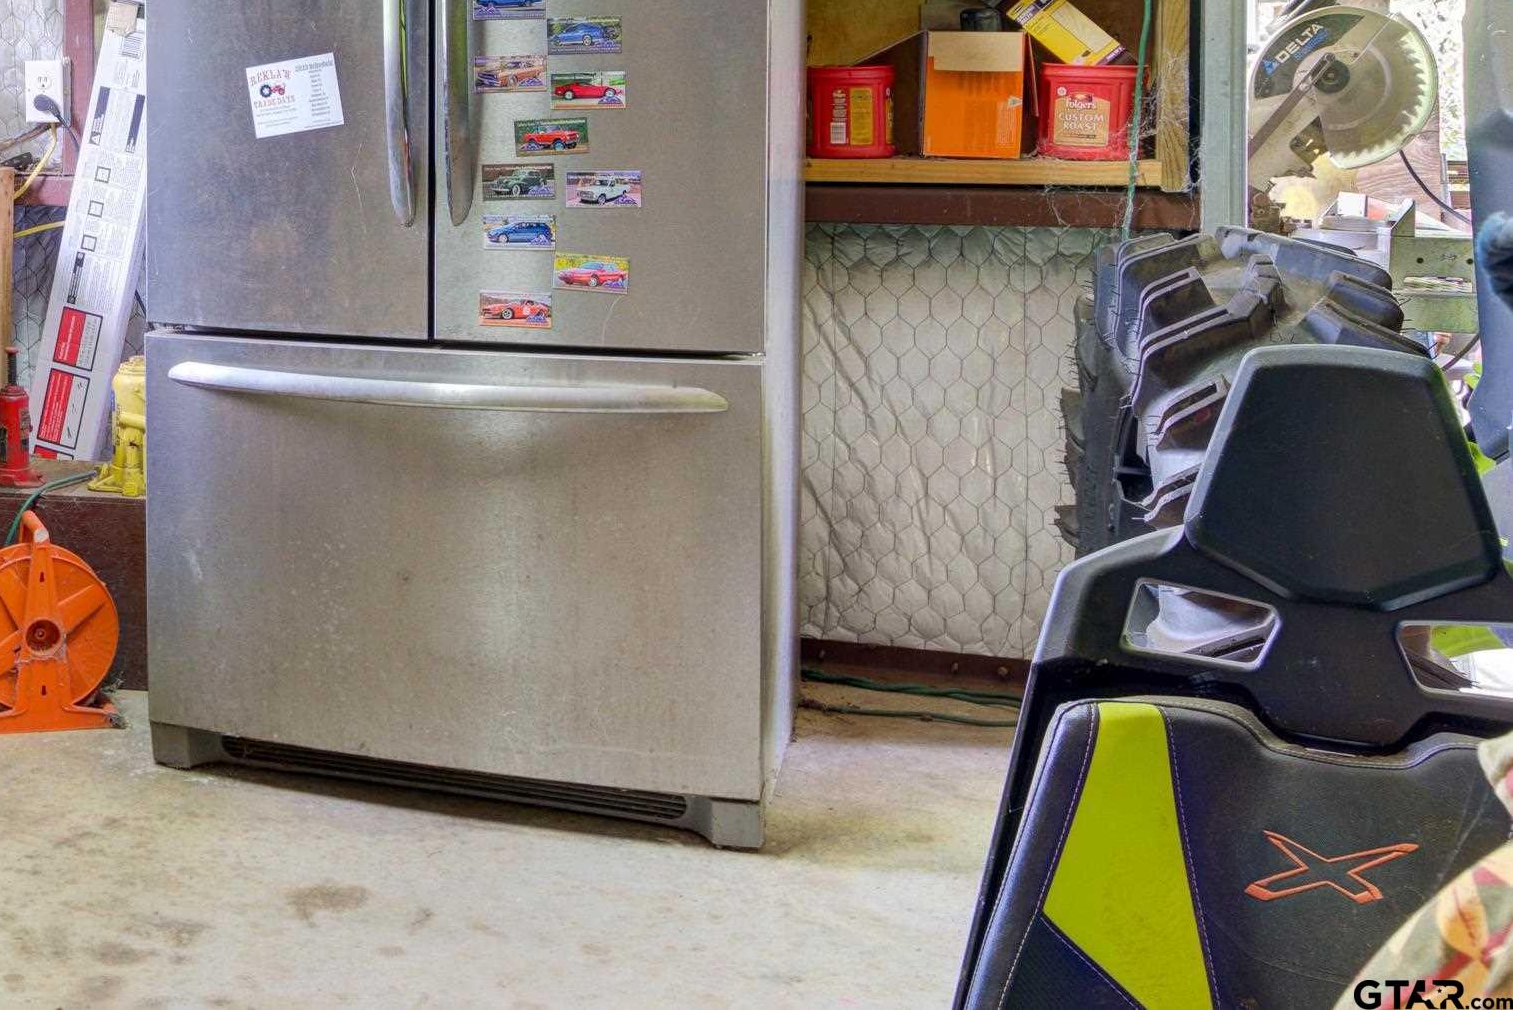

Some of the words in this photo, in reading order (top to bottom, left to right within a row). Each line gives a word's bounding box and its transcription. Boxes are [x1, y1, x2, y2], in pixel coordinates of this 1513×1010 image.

[1274, 23, 1324, 64] DELTA
[1058, 113, 1104, 122] CUSTOM
[1063, 121, 1097, 130] ROAST
